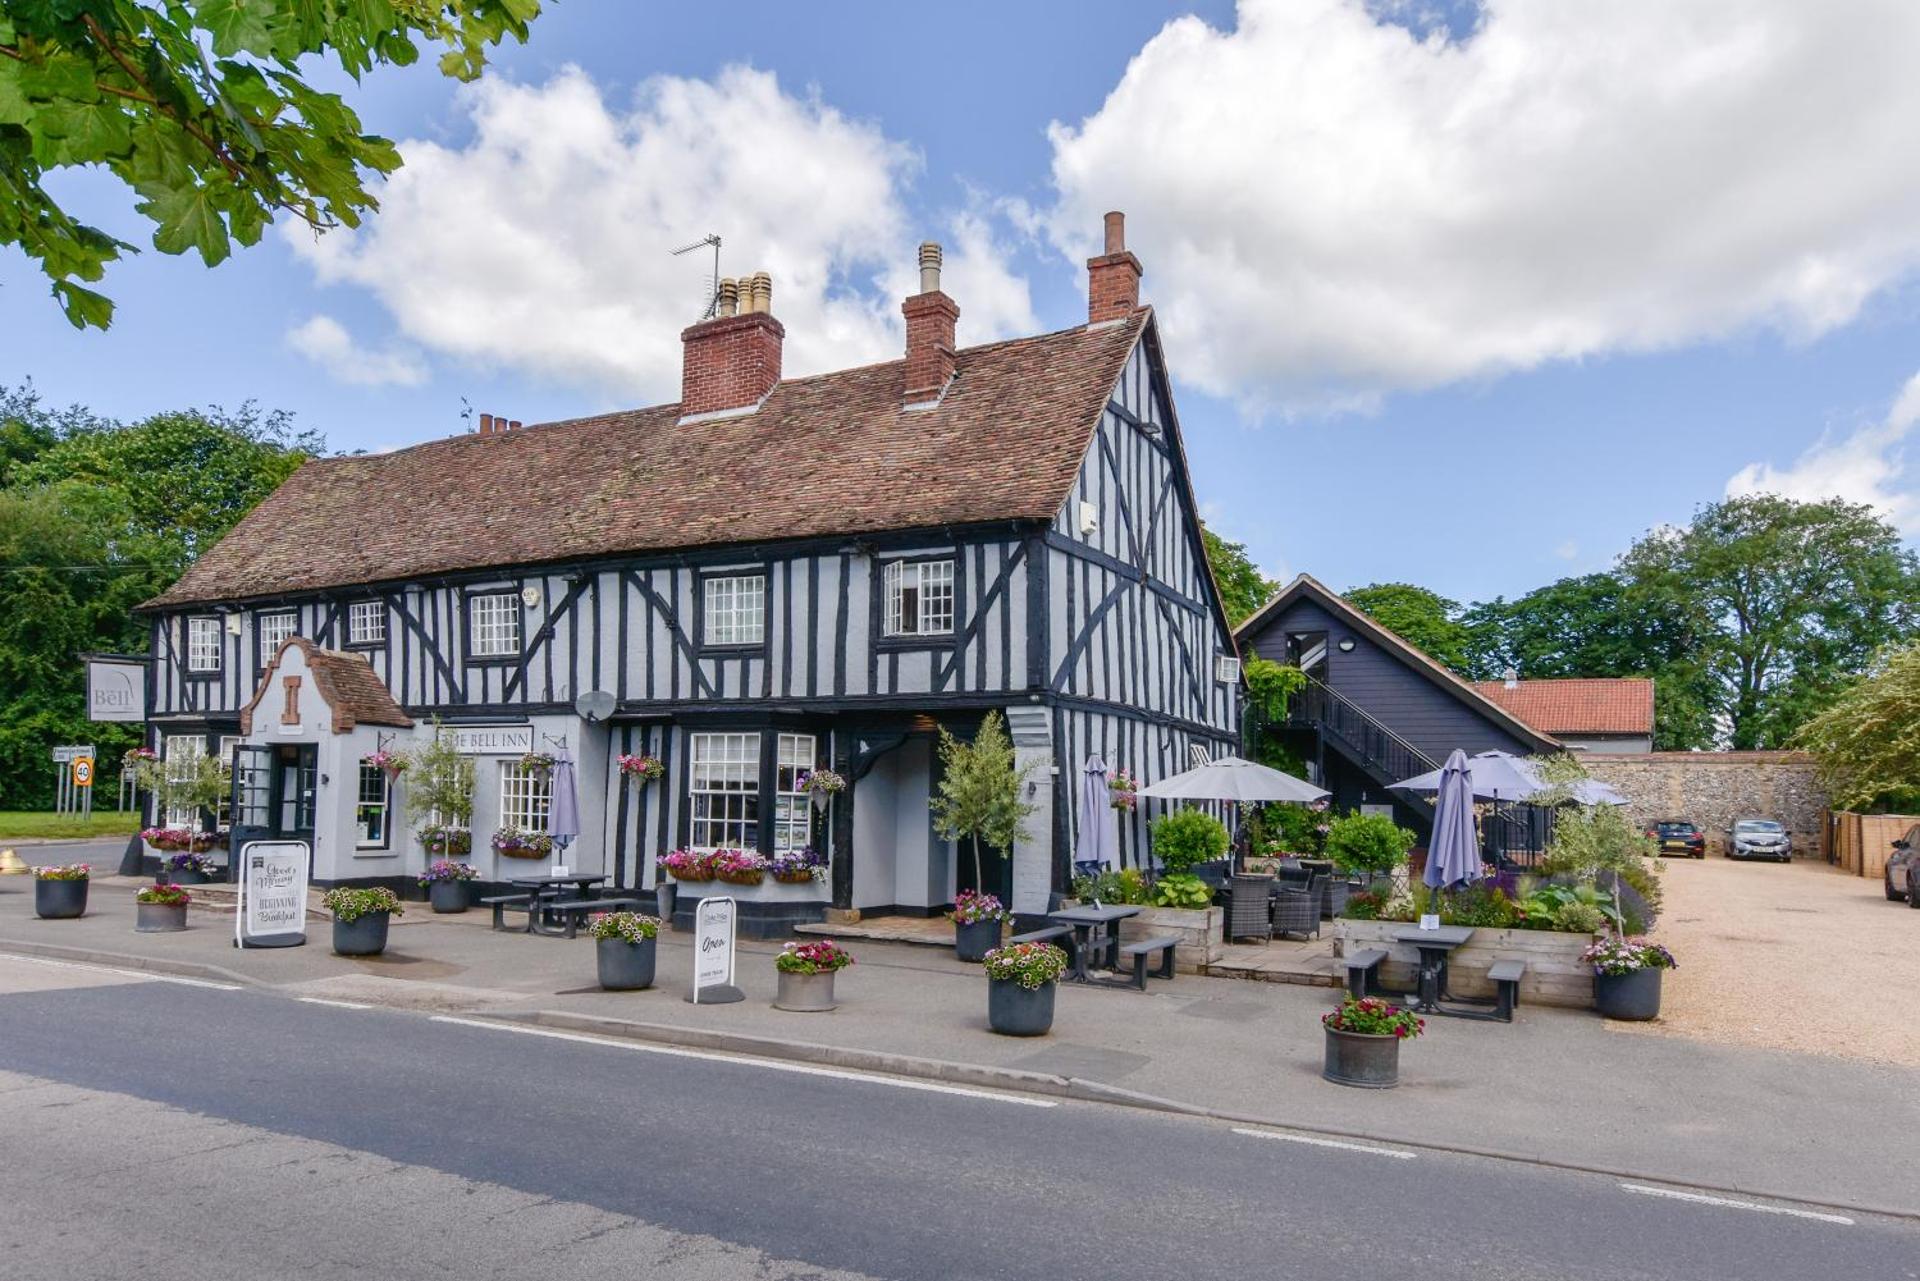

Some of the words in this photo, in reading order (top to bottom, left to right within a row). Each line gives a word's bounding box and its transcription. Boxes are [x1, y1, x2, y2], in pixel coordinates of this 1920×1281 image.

[471, 733, 497, 747] BELL
[502, 733, 528, 747] INN
[77, 767, 89, 777] 40
[702, 936, 726, 953] Open
